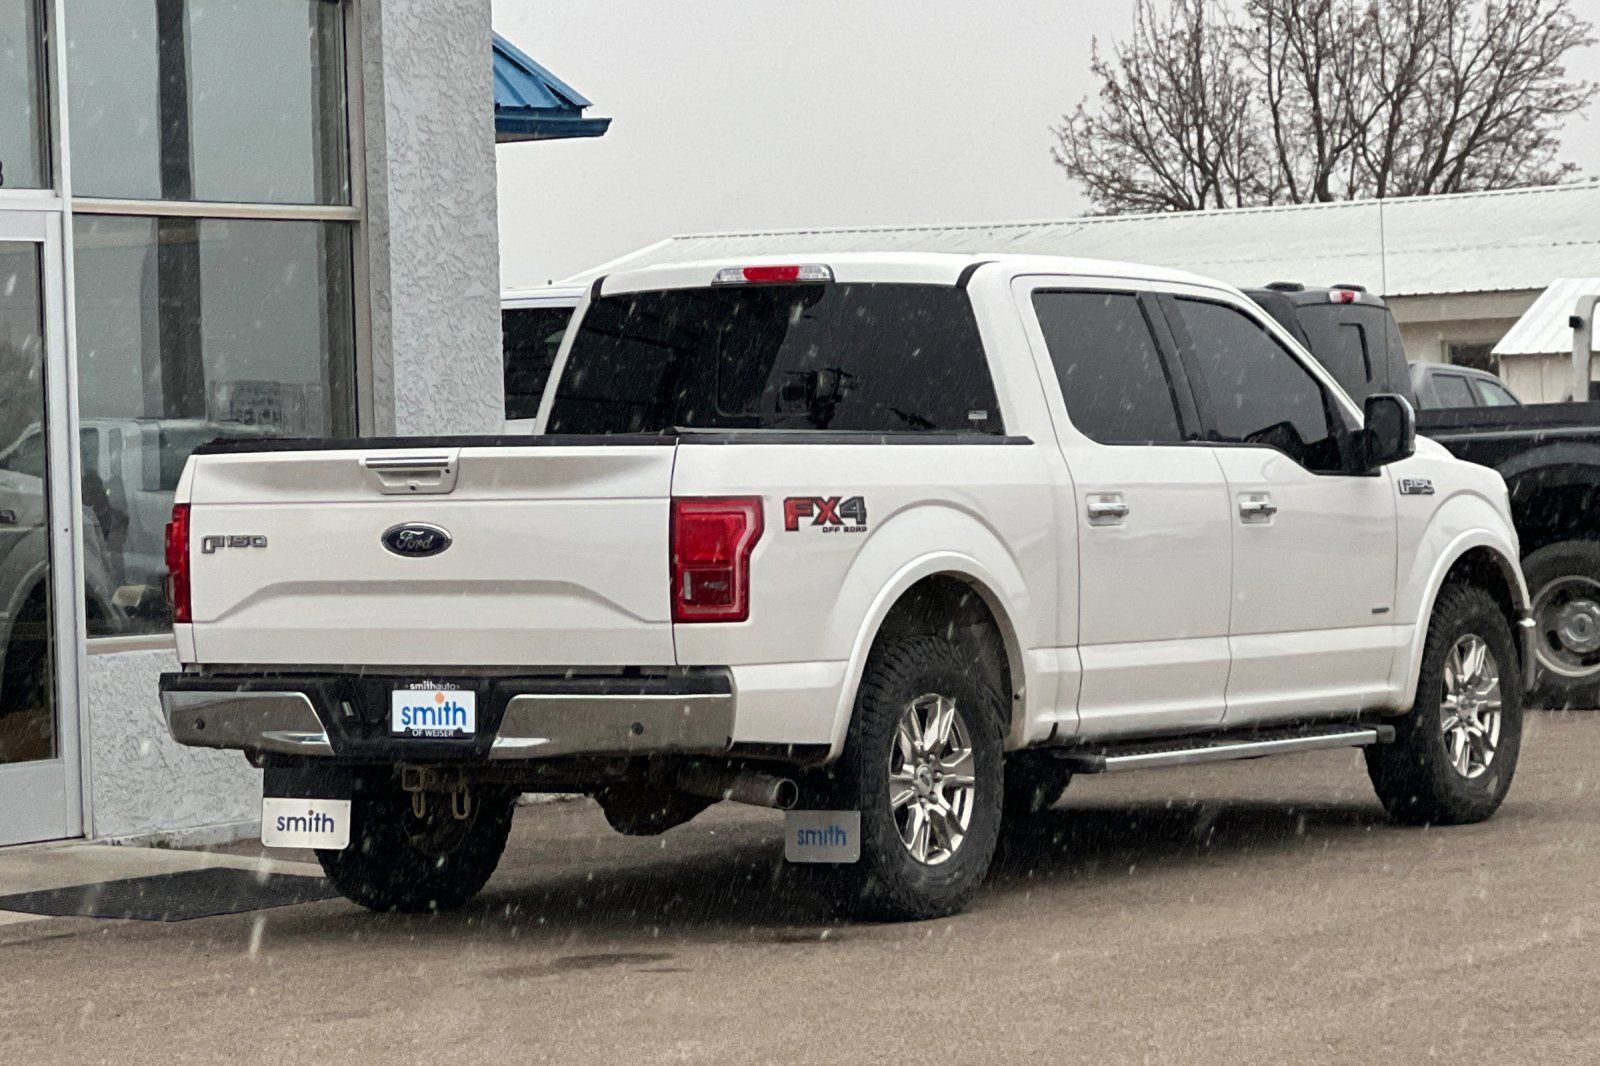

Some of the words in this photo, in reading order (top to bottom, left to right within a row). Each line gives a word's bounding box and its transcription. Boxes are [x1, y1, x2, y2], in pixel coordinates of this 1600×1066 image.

[783, 496, 867, 532] FX4
[396, 530, 434, 549] Ford
[401, 692, 467, 726] smith
[425, 729, 454, 737] WEISER
[276, 809, 335, 833] smith
[797, 815, 847, 846] smith
